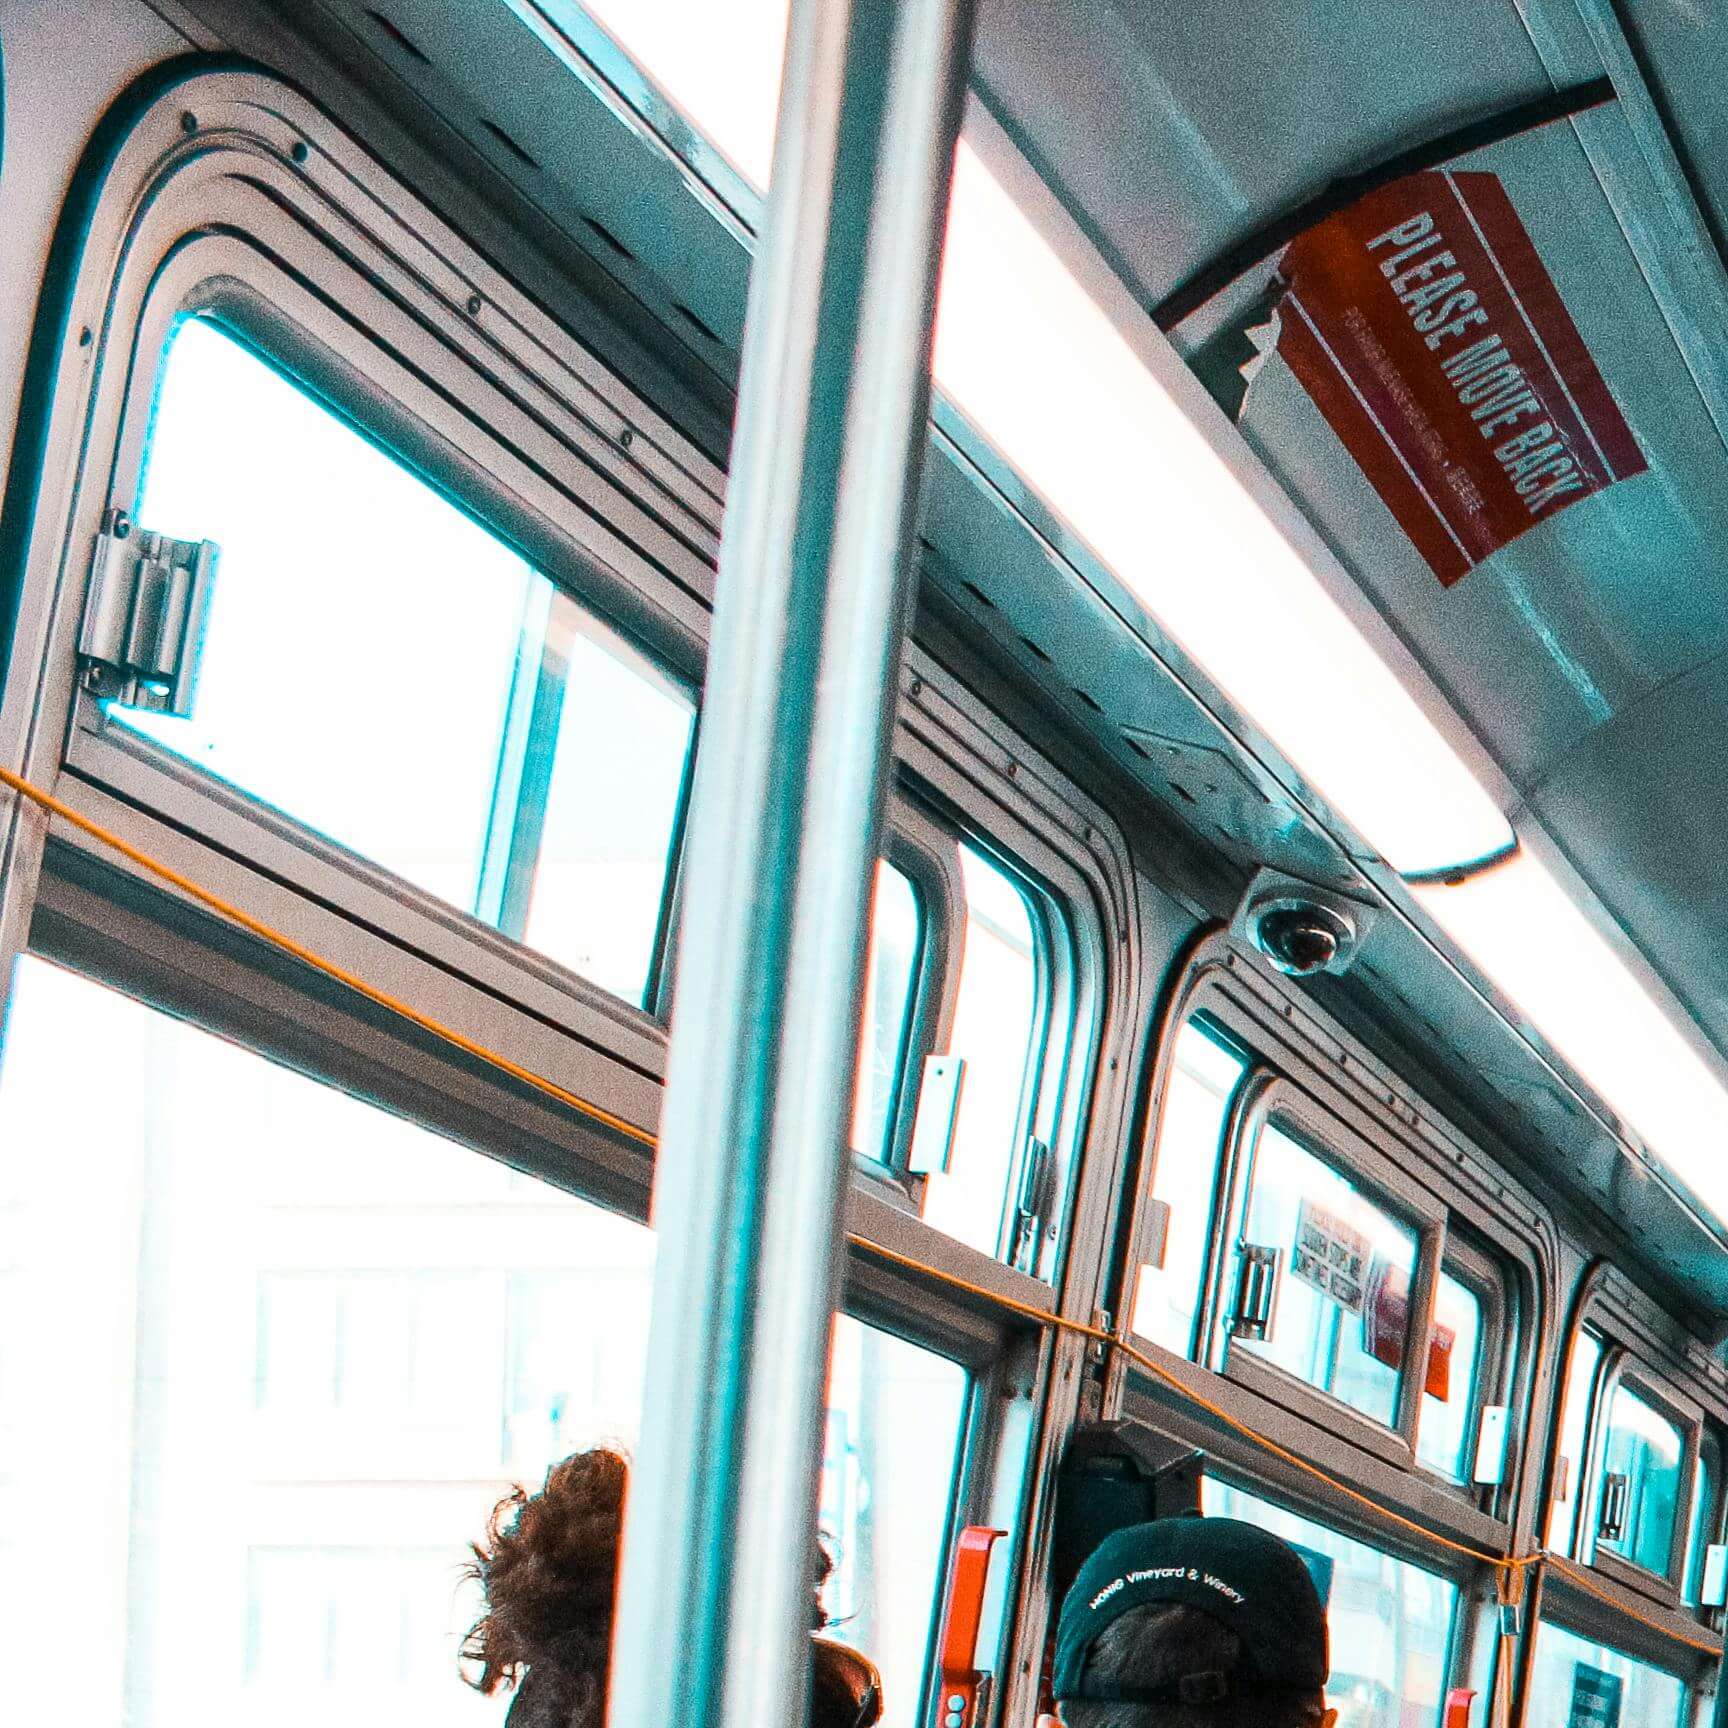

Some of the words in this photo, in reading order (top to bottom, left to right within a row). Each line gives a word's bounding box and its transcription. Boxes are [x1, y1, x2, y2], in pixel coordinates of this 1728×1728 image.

[1366, 211, 1488, 351] PLEASE
[1441, 332, 1540, 438] MOVE
[1494, 422, 1590, 513] BACK
[1126, 1566, 1186, 1584] Vineyard
[1187, 1568, 1200, 1581] &
[1203, 1570, 1245, 1604] Winery
